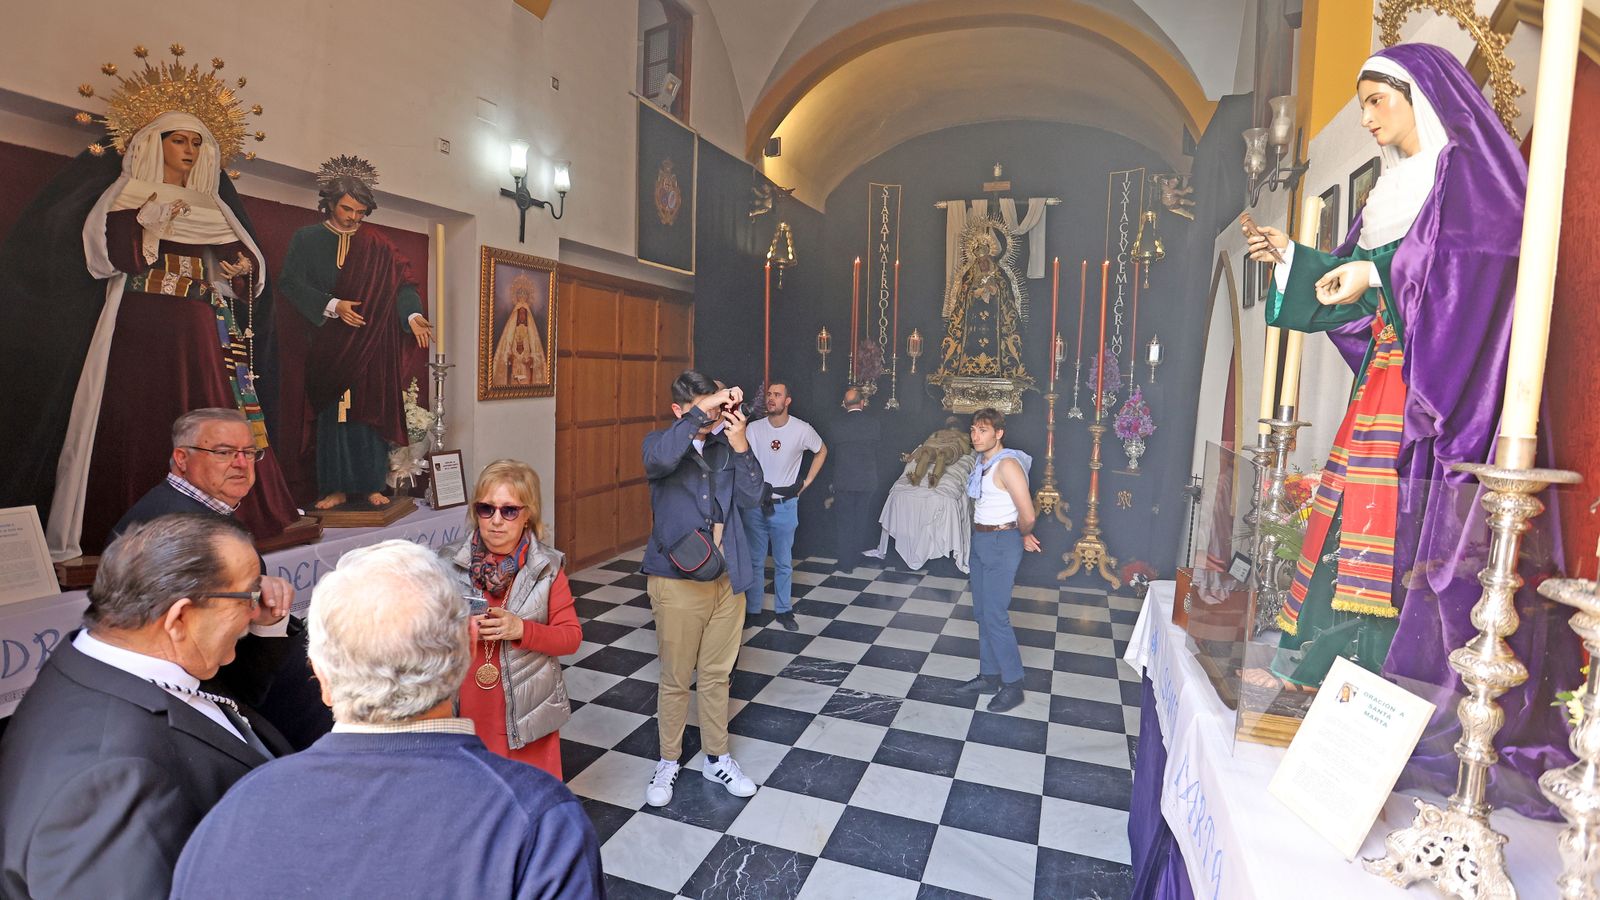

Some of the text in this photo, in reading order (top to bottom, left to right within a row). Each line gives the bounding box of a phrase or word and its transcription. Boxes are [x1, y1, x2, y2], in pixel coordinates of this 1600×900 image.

[880, 186, 890, 241] STABAT
[1111, 285, 1126, 364] LACRIMO
[1363, 710, 1388, 728] MARTA
[1367, 703, 1392, 720] SANTA
